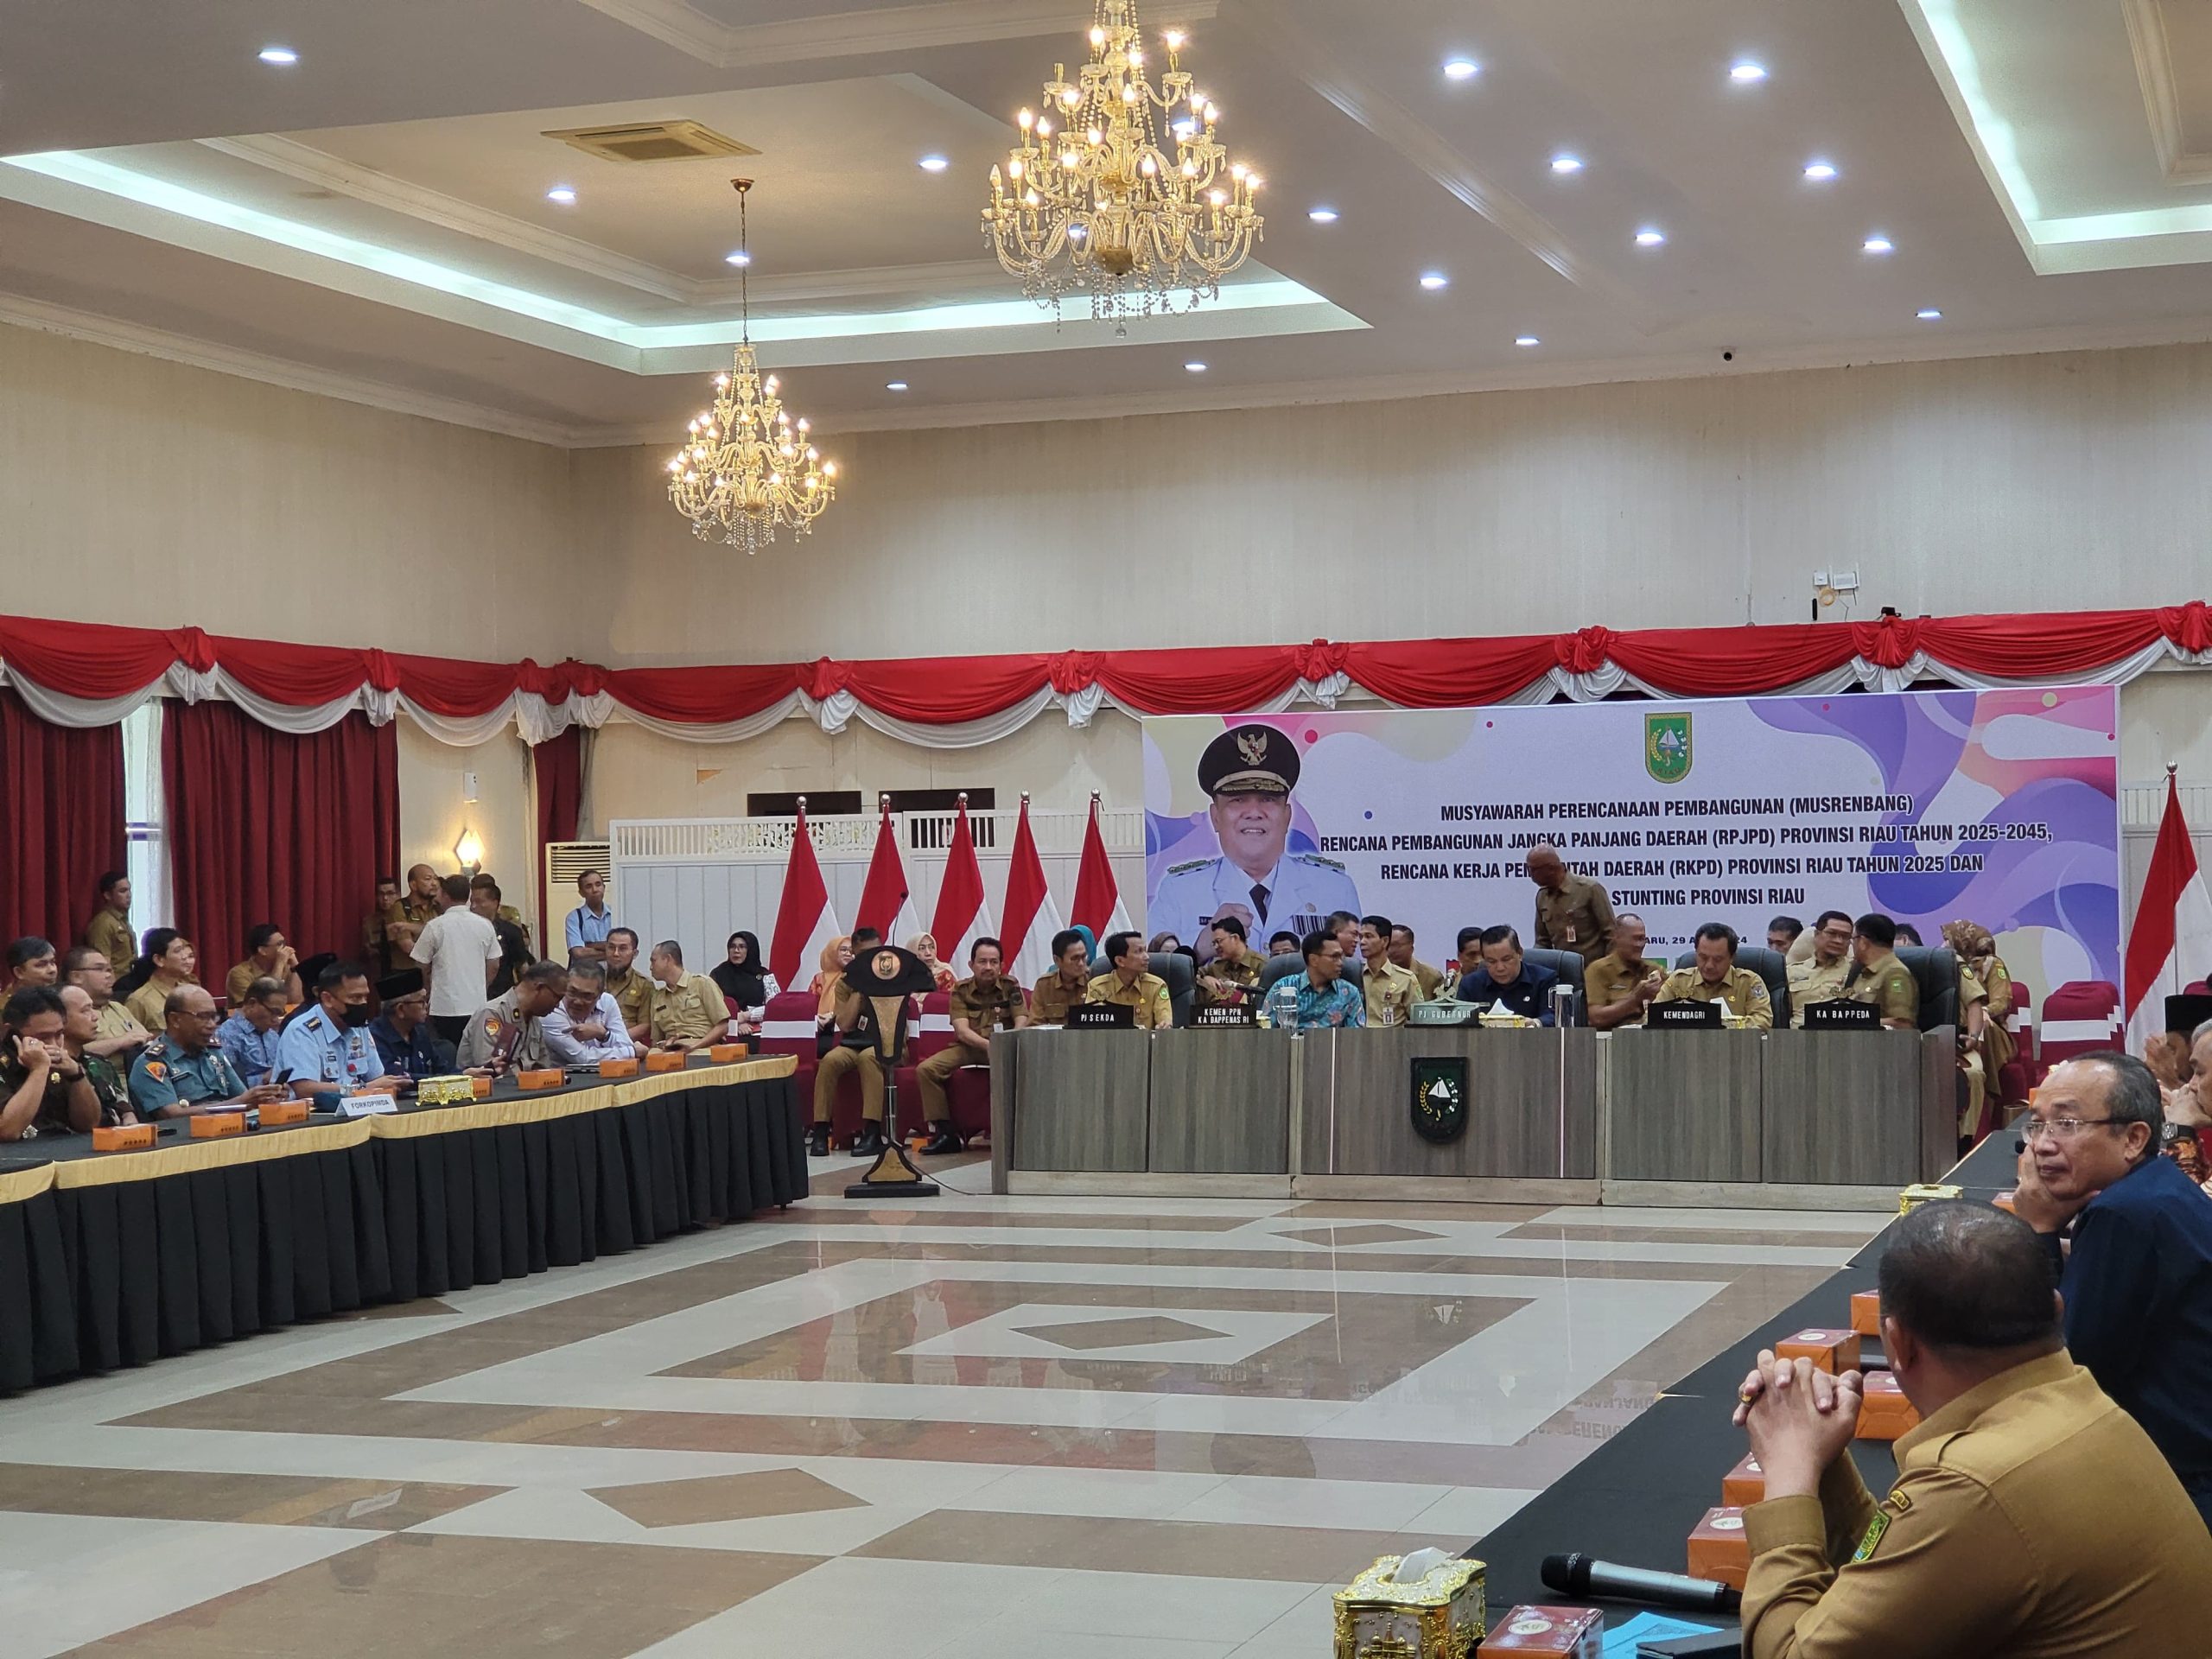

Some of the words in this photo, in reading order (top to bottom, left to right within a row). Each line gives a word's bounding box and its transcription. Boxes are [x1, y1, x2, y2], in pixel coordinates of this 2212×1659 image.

[1441, 804, 1544, 821] MUSYAWARAH
[1548, 801, 1660, 819] PERENCANAAN
[1664, 798, 1784, 817] PEMBANGUNAN
[1789, 795, 1914, 816] (MUSRENBANG)
[1320, 836, 1388, 852] RENCANA
[1392, 834, 1503, 851] PEMBANGUNAN
[1507, 832, 1567, 849] JANGKA
[1571, 830, 1641, 848] PANJANG
[1646, 830, 1707, 846] DAERAH
[1713, 829, 1776, 849] (RPJPD)
[1780, 826, 1854, 844] PROVINSI
[1859, 826, 1897, 842] RIAU
[1902, 825, 1954, 842] TAHUN
[1958, 823, 2053, 842] 2025-2045,
[1381, 863, 1449, 880] RENCANA
[1453, 862, 1501, 879] KERJA
[1504, 861, 1599, 878] PENTAH
[1604, 860, 1664, 876] DAERAH
[1669, 859, 1723, 880] (RKPD)
[1728, 858, 1801, 874] PROVINSI
[1806, 857, 1843, 874] RIAU
[1847, 856, 1899, 873] TAHUN
[1904, 855, 1945, 872] 2025
[1949, 855, 1984, 871] DAN
[1611, 889, 1686, 906] STUNTING
[1690, 888, 1763, 905] PROVINSI
[1768, 888, 1805, 904] RIAU
[1204, 1007, 1226, 1016] KEMEN
[1431, 1010, 1471, 1019] GUBERNUR
[1663, 1010, 1706, 1020] KEMENDAGRI
[1816, 1010, 1827, 1019] KA
[1832, 1010, 1870, 1019] BAPPEDA
[1080, 1014, 1087, 1022] PJ
[1089, 1014, 1115, 1022] SEKDA
[1198, 1015, 1207, 1024] KA
[1210, 1014, 1241, 1024] BAPPENAS
[1243, 1014, 1249, 1024] RI
